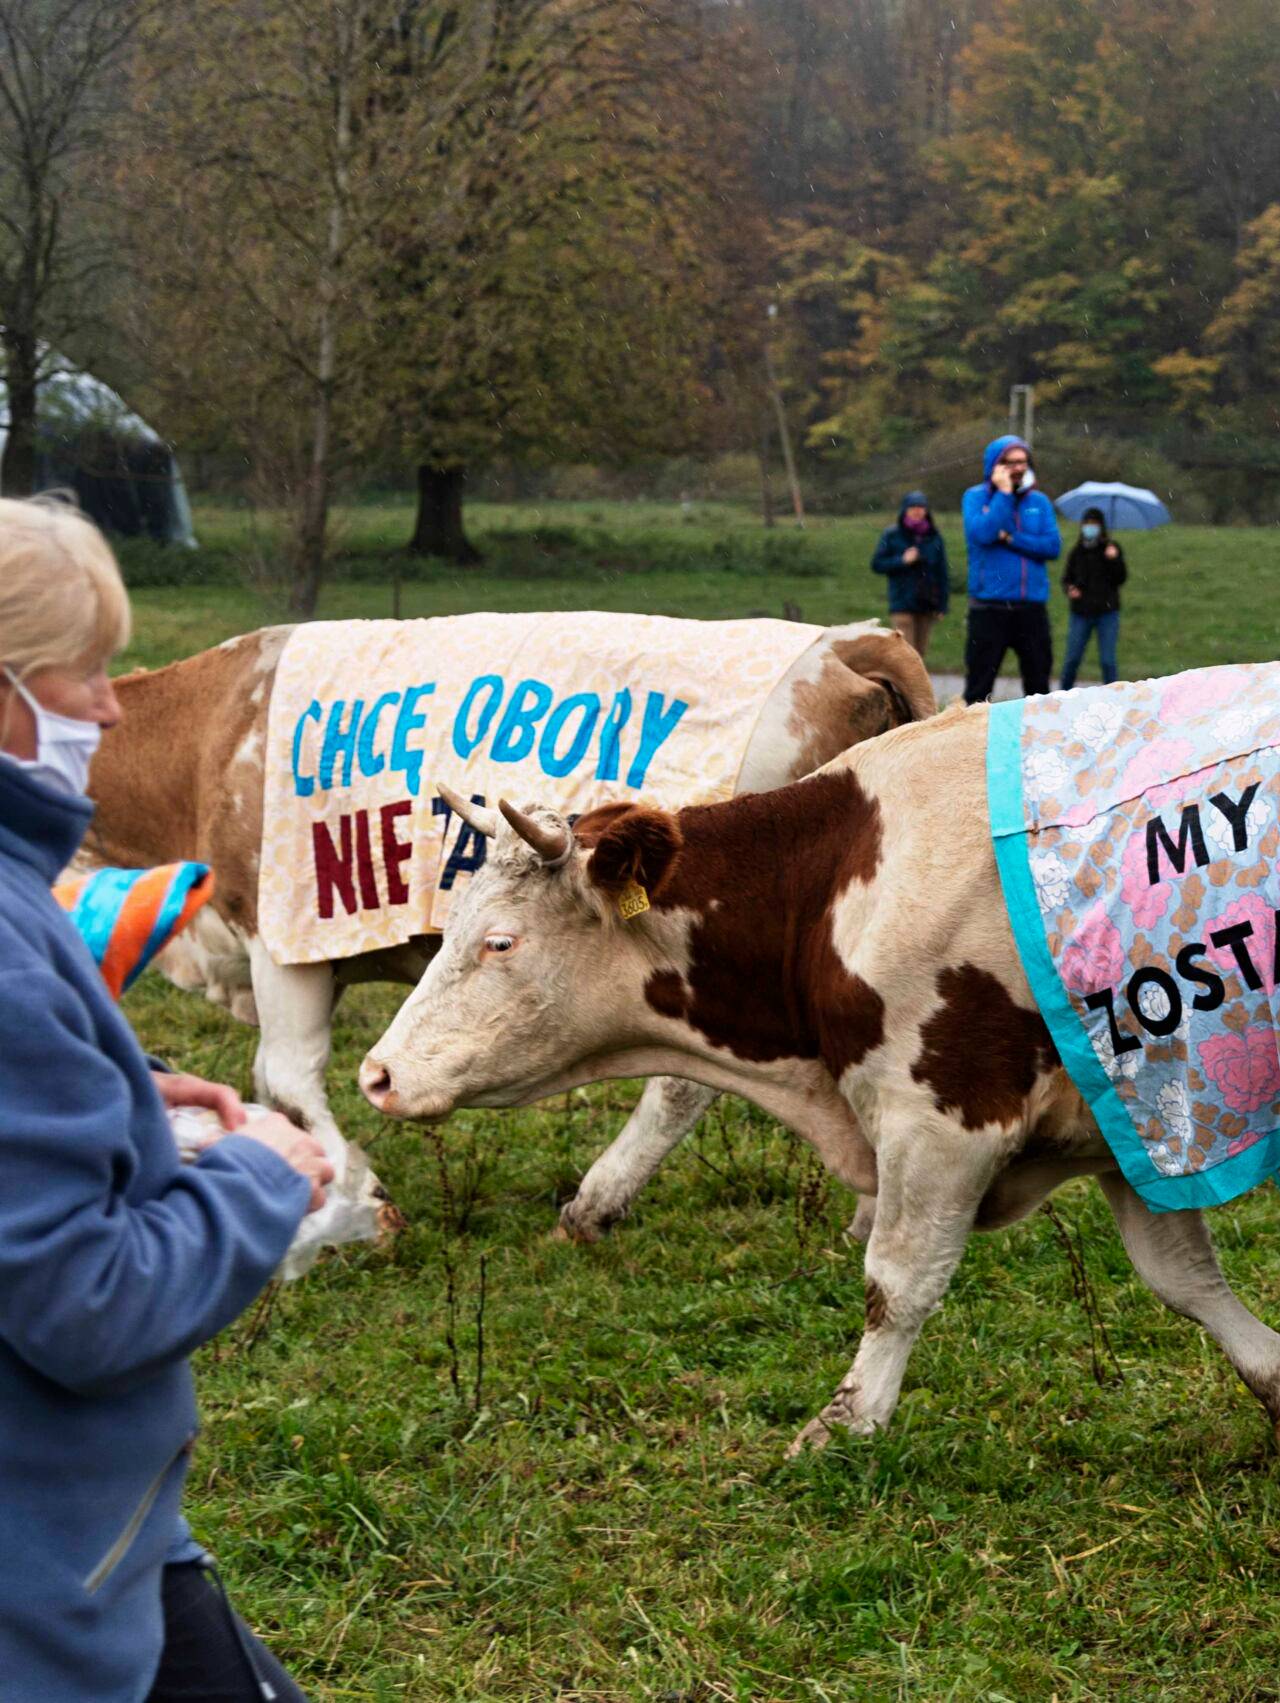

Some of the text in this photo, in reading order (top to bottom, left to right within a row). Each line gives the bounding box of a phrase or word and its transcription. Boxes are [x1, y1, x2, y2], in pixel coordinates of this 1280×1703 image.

[451, 673, 689, 790] OBORY
[311, 800, 413, 919] NIE
[1145, 781, 1263, 886] MY
